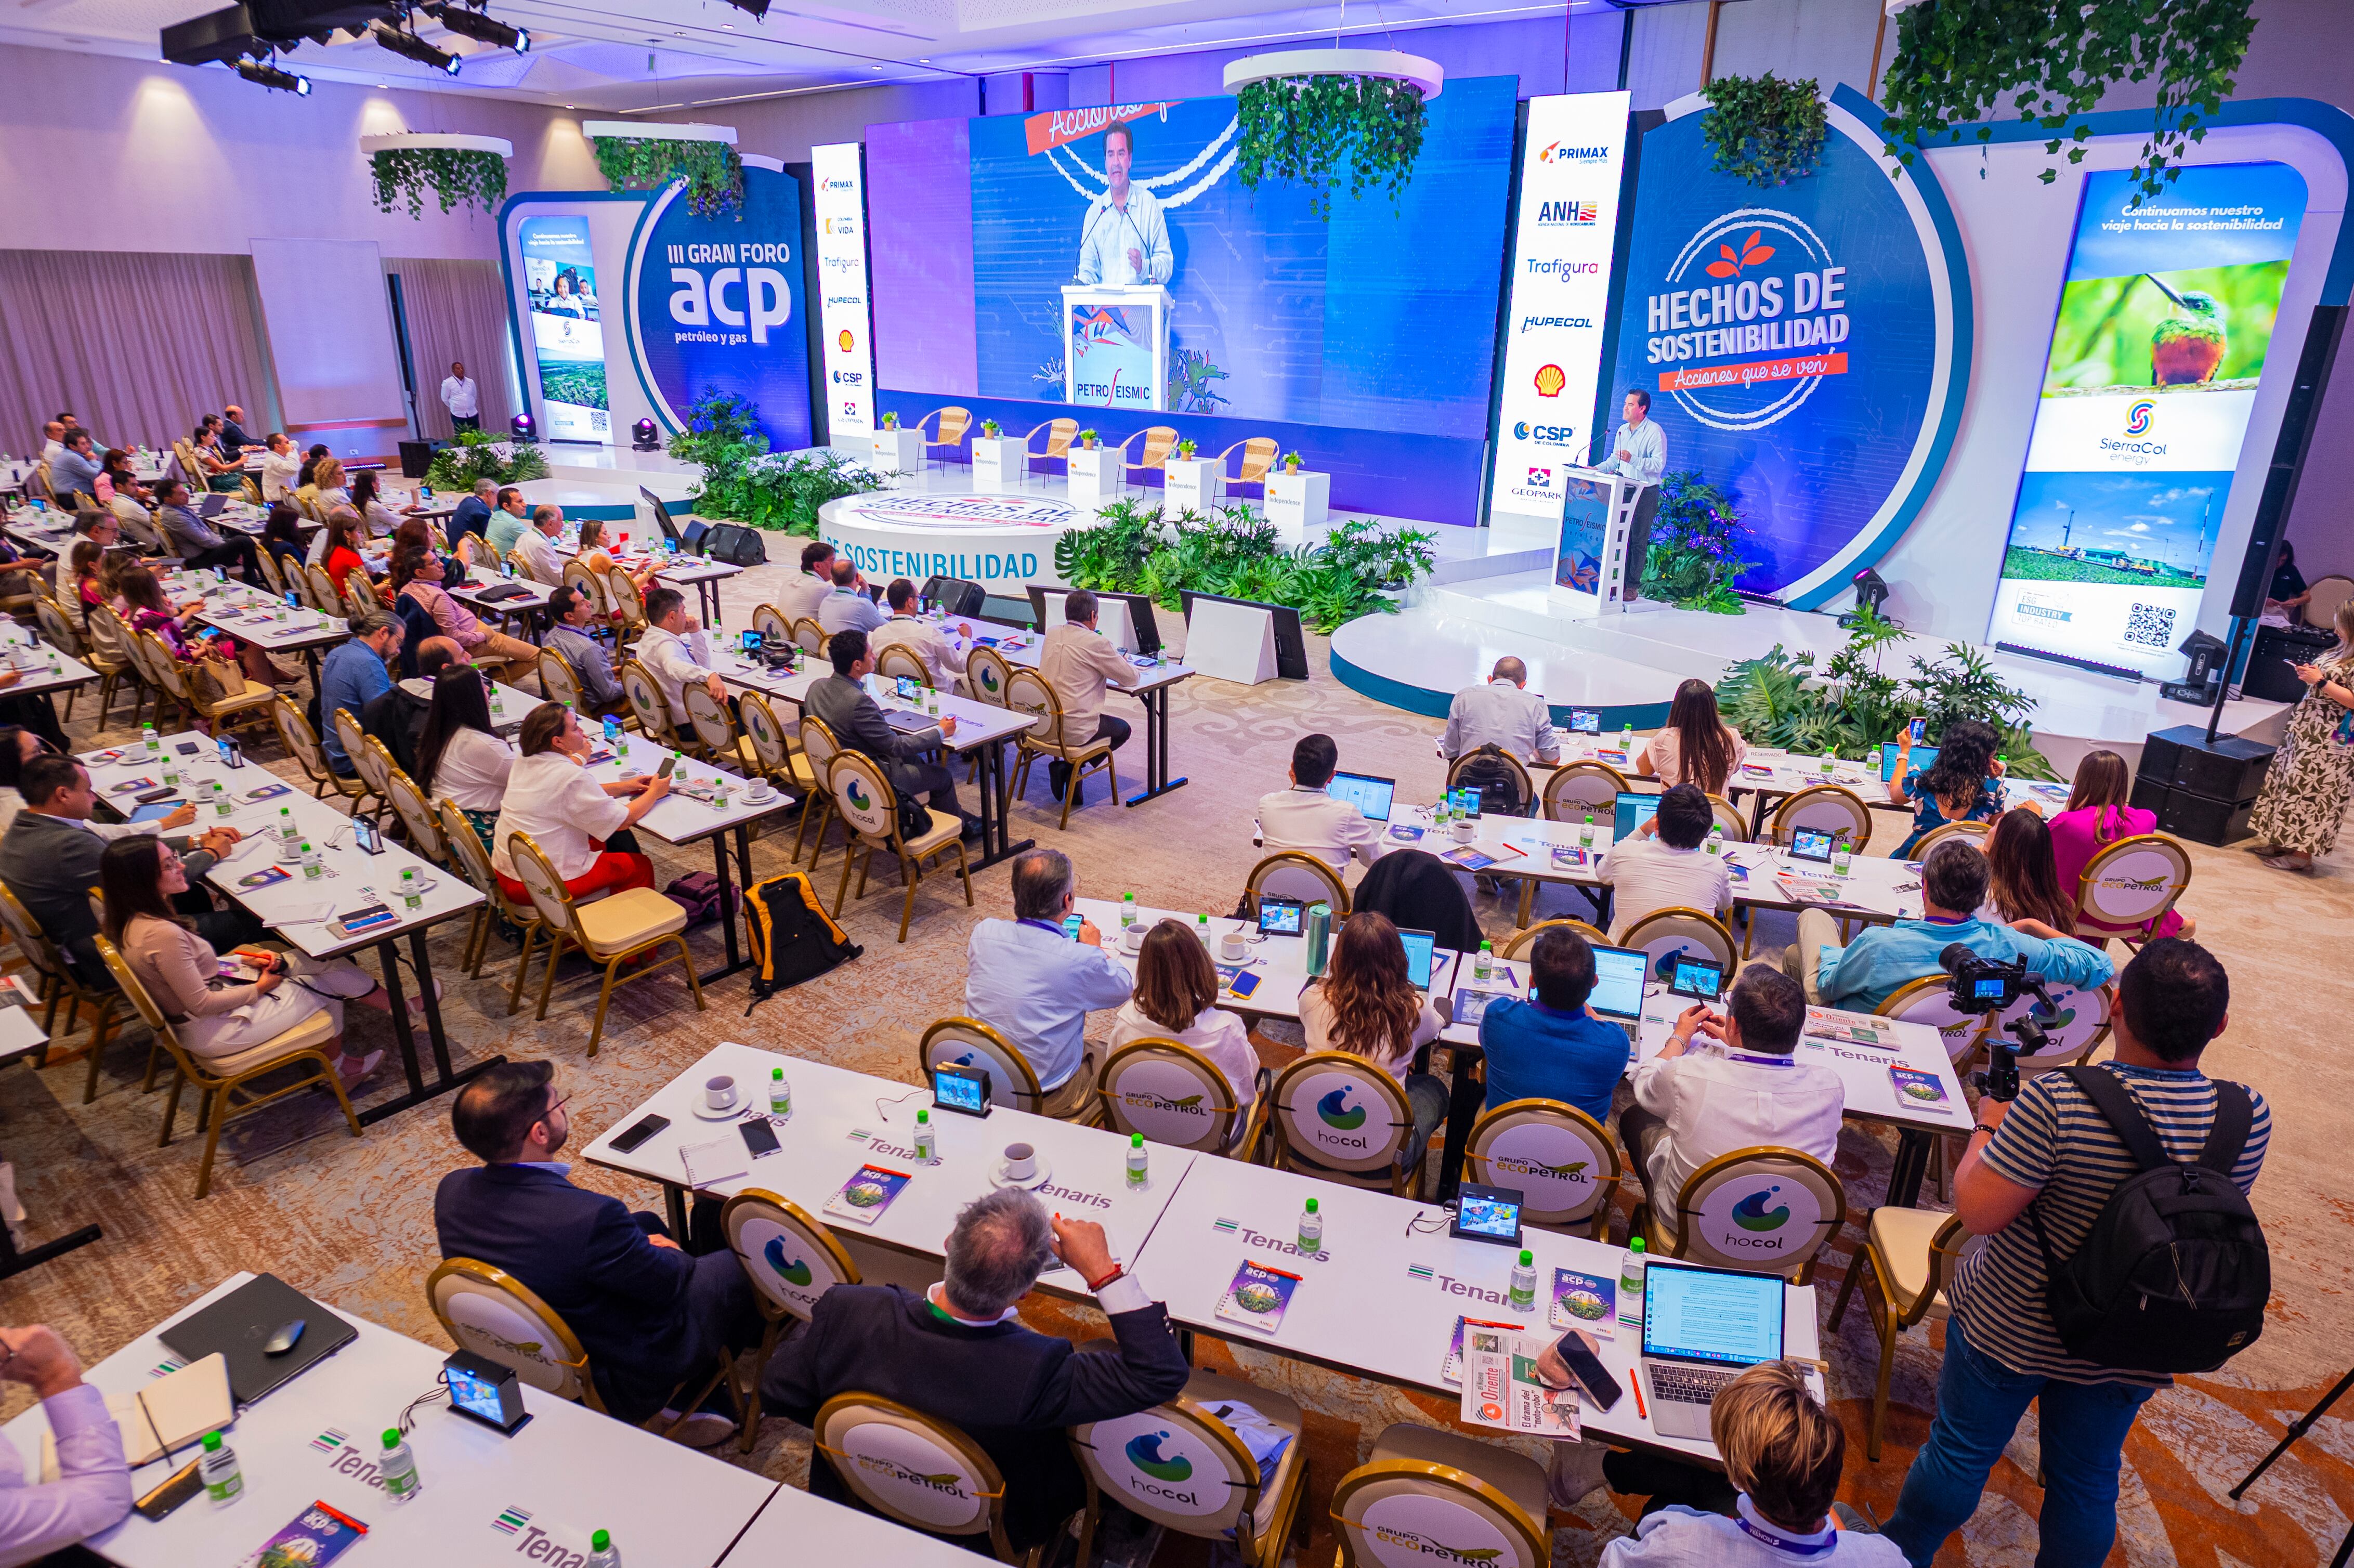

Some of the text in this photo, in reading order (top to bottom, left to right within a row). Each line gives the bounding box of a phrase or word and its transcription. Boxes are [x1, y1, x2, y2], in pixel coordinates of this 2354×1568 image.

[1559, 147, 1608, 159] PRIMAX
[1538, 201, 1579, 221] ANH
[2122, 205, 2263, 217] Continuamos nuestro
[2101, 217, 2283, 233] viaje hacia la sostenibilidad
[668, 243, 790, 264] III GRAN FORO
[825, 257, 859, 273] Trafigura
[1527, 259, 1598, 283] Trafigura
[669, 267, 791, 344] acp
[828, 297, 861, 309] HUPECOL
[1647, 266, 1847, 333] HECHOS DE
[1522, 317, 1592, 333] HUPECOL
[675, 331, 748, 345] petróleo y gas
[1646, 313, 1850, 364] SOSTENIBILIDAD
[843, 372, 862, 383] CSP
[1674, 359, 1828, 389] Acciones que se ven
[1534, 425, 1573, 441] CSP
[2099, 438, 2167, 456] SierraCol
[2110, 452, 2150, 466] energy
[1169, 481, 1197, 490] Independence
[1269, 496, 1301, 506] Independence
[1512, 488, 1562, 500] GEOPARK
[878, 497, 1018, 513] HECHOS
[845, 543, 1038, 579] SOSTENIBILIDAD
[2022, 595, 2037, 605] ESG
[2020, 604, 2063, 620] INDUSTRY
[851, 811, 876, 826] hocol
[1538, 841, 1581, 850] Tenar
[1825, 1014, 1856, 1025] Oriente
[1829, 1046, 1911, 1068] Tenaris
[738, 1108, 789, 1128] naris
[1317, 1129, 1368, 1149] hocol
[868, 1138, 944, 1167] Tenas
[1498, 1156, 1528, 1166] GRUPO
[862, 1169, 882, 1179] acp
[1038, 1181, 1113, 1210] enaris
[1241, 1228, 1331, 1263] Tenas
[1725, 1233, 1783, 1249] hocol
[1246, 1266, 1267, 1278] acp
[1561, 1274, 1584, 1286] acp
[778, 1282, 821, 1304] hoco
[1481, 1367, 1498, 1401] Oriente
[1521, 1389, 1530, 1400] del
[1522, 1401, 1531, 1421] drama
[857, 1454, 893, 1469] GRUPO
[329, 1445, 408, 1497] Tena
[1131, 1475, 1199, 1506] hocol
[303, 1509, 331, 1531] acp
[1377, 1526, 1419, 1543] GRUPO
